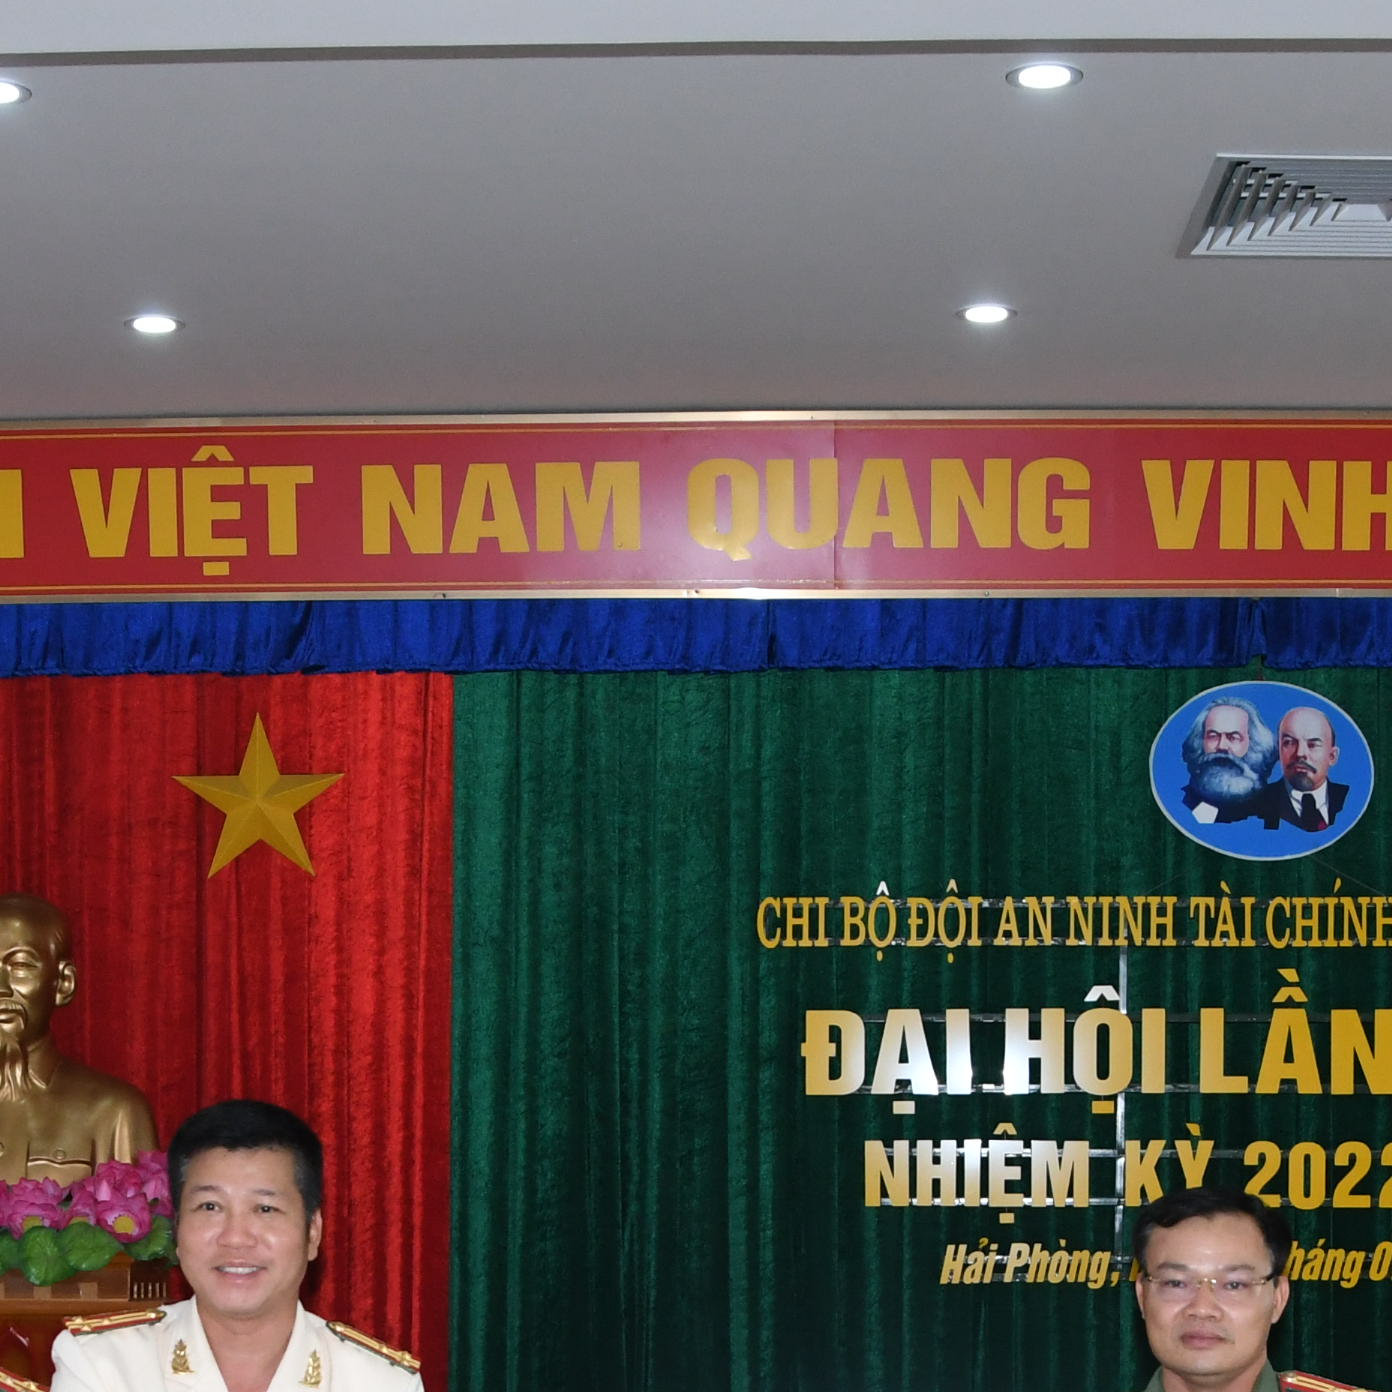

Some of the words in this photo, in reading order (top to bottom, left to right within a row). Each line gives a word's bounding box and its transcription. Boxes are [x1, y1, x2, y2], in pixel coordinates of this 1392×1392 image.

[71, 446, 313, 576] VIỆT
[362, 462, 640, 555] NAM
[687, 458, 1090, 562] QUANG
[756, 896, 830, 949] CHI
[839, 880, 897, 962] BỘ
[906, 879, 984, 963] ĐỘI
[995, 895, 1055, 947] AN
[1066, 895, 1178, 947] NINH
[1189, 881, 1256, 947] TÀI
[800, 1007, 973, 1115] ĐẠI
[1002, 984, 1166, 1115] HỘI
[864, 1122, 1090, 1224] NHIỆM
[1124, 1122, 1215, 1208] KỲ
[939, 1237, 999, 1285] Hải
[1002, 1238, 1120, 1289] Phòng,
[1280, 1238, 1366, 1290] háng
